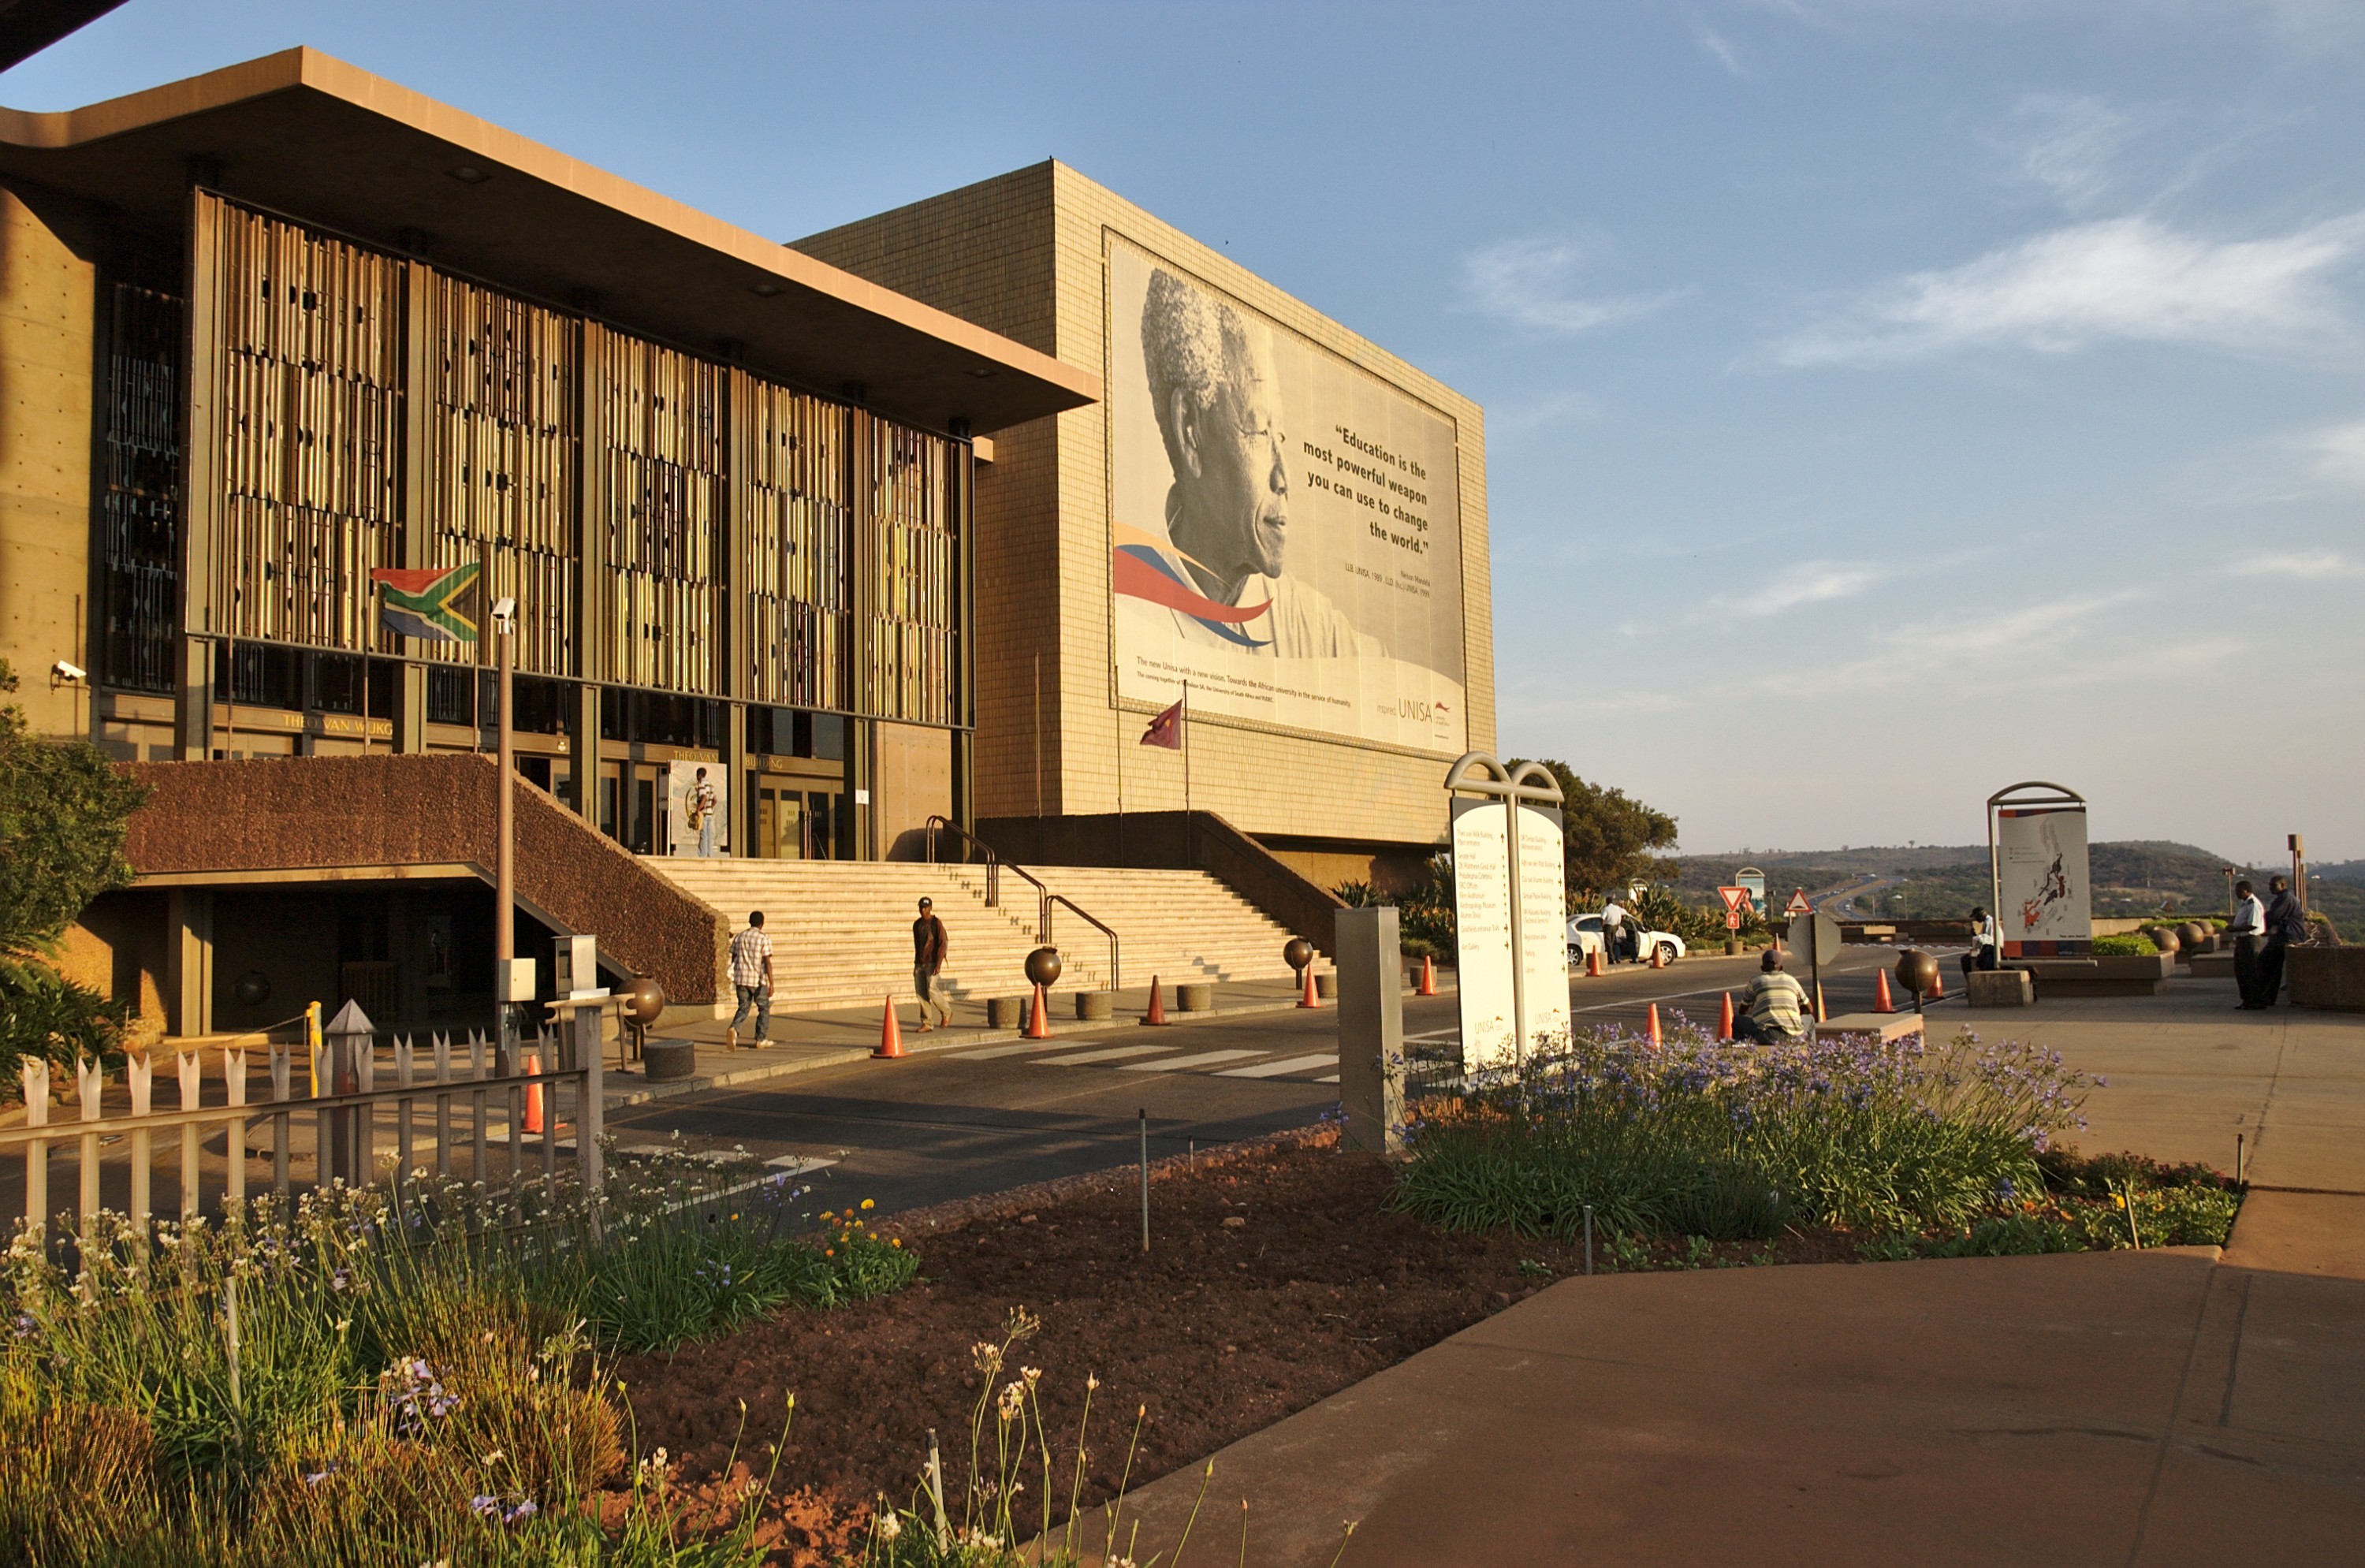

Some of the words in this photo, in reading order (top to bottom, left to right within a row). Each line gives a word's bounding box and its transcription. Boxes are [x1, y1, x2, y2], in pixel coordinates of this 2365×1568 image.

[1335, 424, 1395, 466] “Education
[1399, 455, 1406, 471] is
[1410, 461, 1425, 480] the
[1304, 442, 1332, 464] most
[1337, 456, 1385, 487] powerful
[1388, 480, 1427, 505] weapon
[1308, 471, 1329, 490] you
[1334, 482, 1352, 500] can
[1357, 492, 1375, 509] use
[1379, 498, 1390, 515] to
[1394, 505, 1428, 532] change
[1370, 522, 1387, 541] the
[1391, 531, 1428, 554] world.”
[1137, 656, 1148, 665] The
[1163, 662, 1178, 672] Unisa
[1179, 666, 1191, 675] with
[1209, 672, 1225, 682] vision.
[1227, 675, 1247, 686] Towards
[1258, 681, 1274, 691] African
[1276, 686, 1297, 698] university
[1213, 687, 1230, 695] University
[283, 715, 317, 728] THEO
[323, 718, 349, 732] VAN
[1399, 698, 1432, 724] UNISA
[674, 750, 696, 761] THEO
[699, 753, 718, 763] VAN
[746, 756, 782, 769] BUILDING
